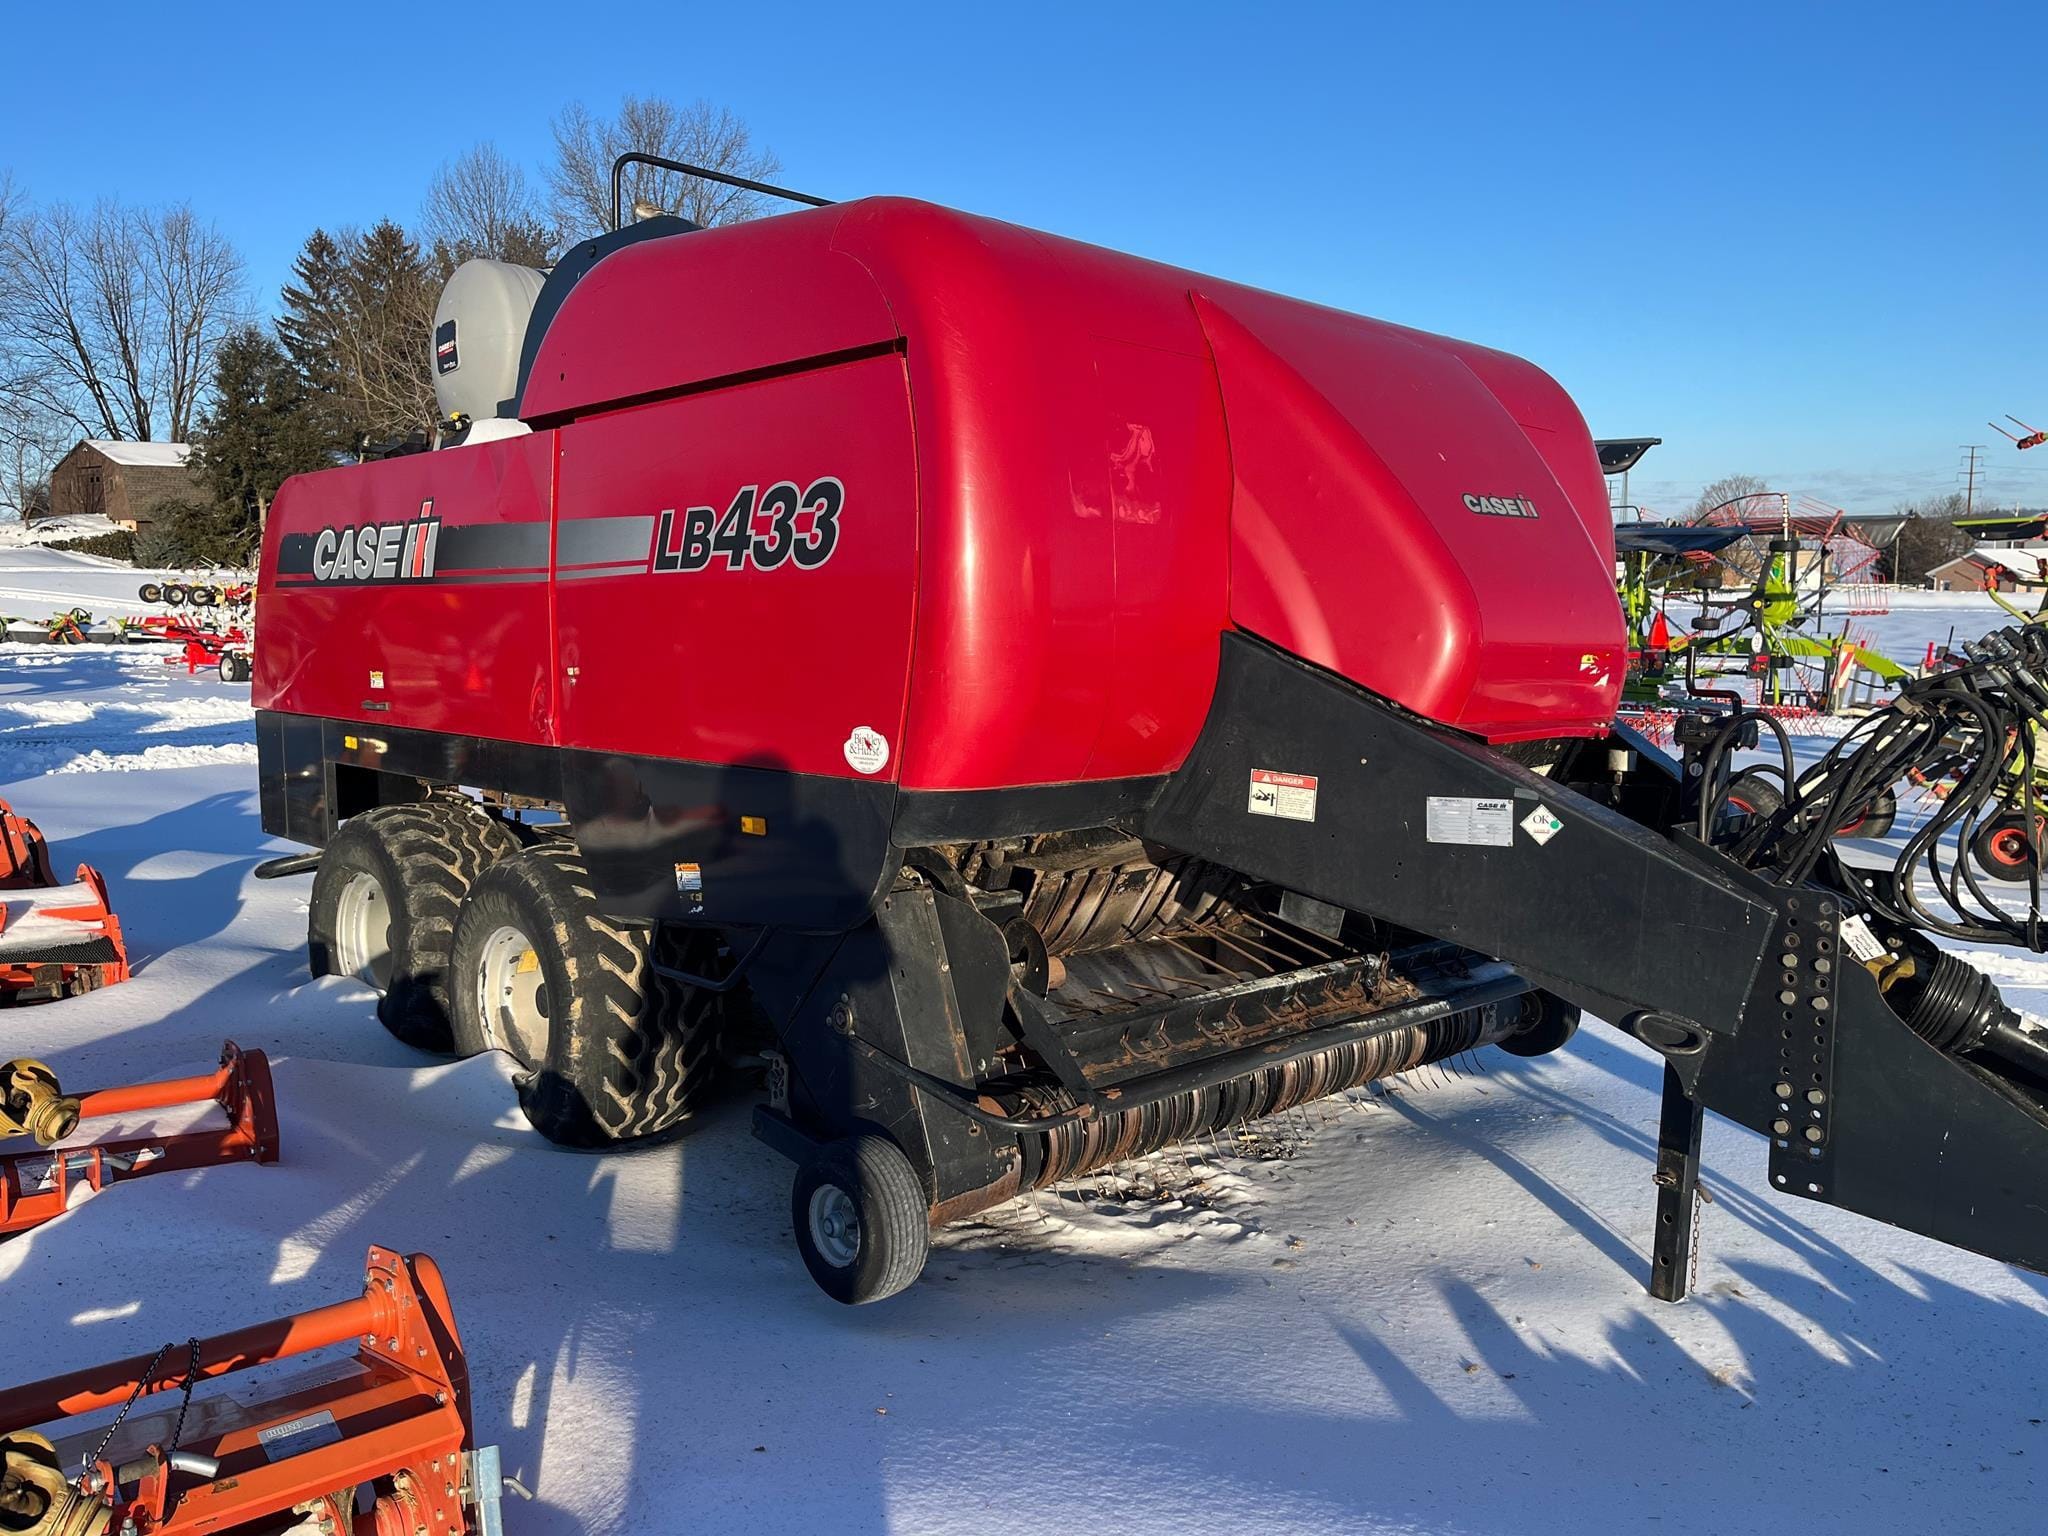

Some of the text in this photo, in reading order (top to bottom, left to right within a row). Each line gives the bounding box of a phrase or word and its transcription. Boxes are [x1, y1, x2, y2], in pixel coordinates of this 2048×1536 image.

[1462, 494, 1520, 516] CASE
[652, 476, 845, 574] LB433
[312, 525, 403, 582] CASE
[1272, 775, 1304, 785] DANGER
[1532, 814, 1550, 825] OK
